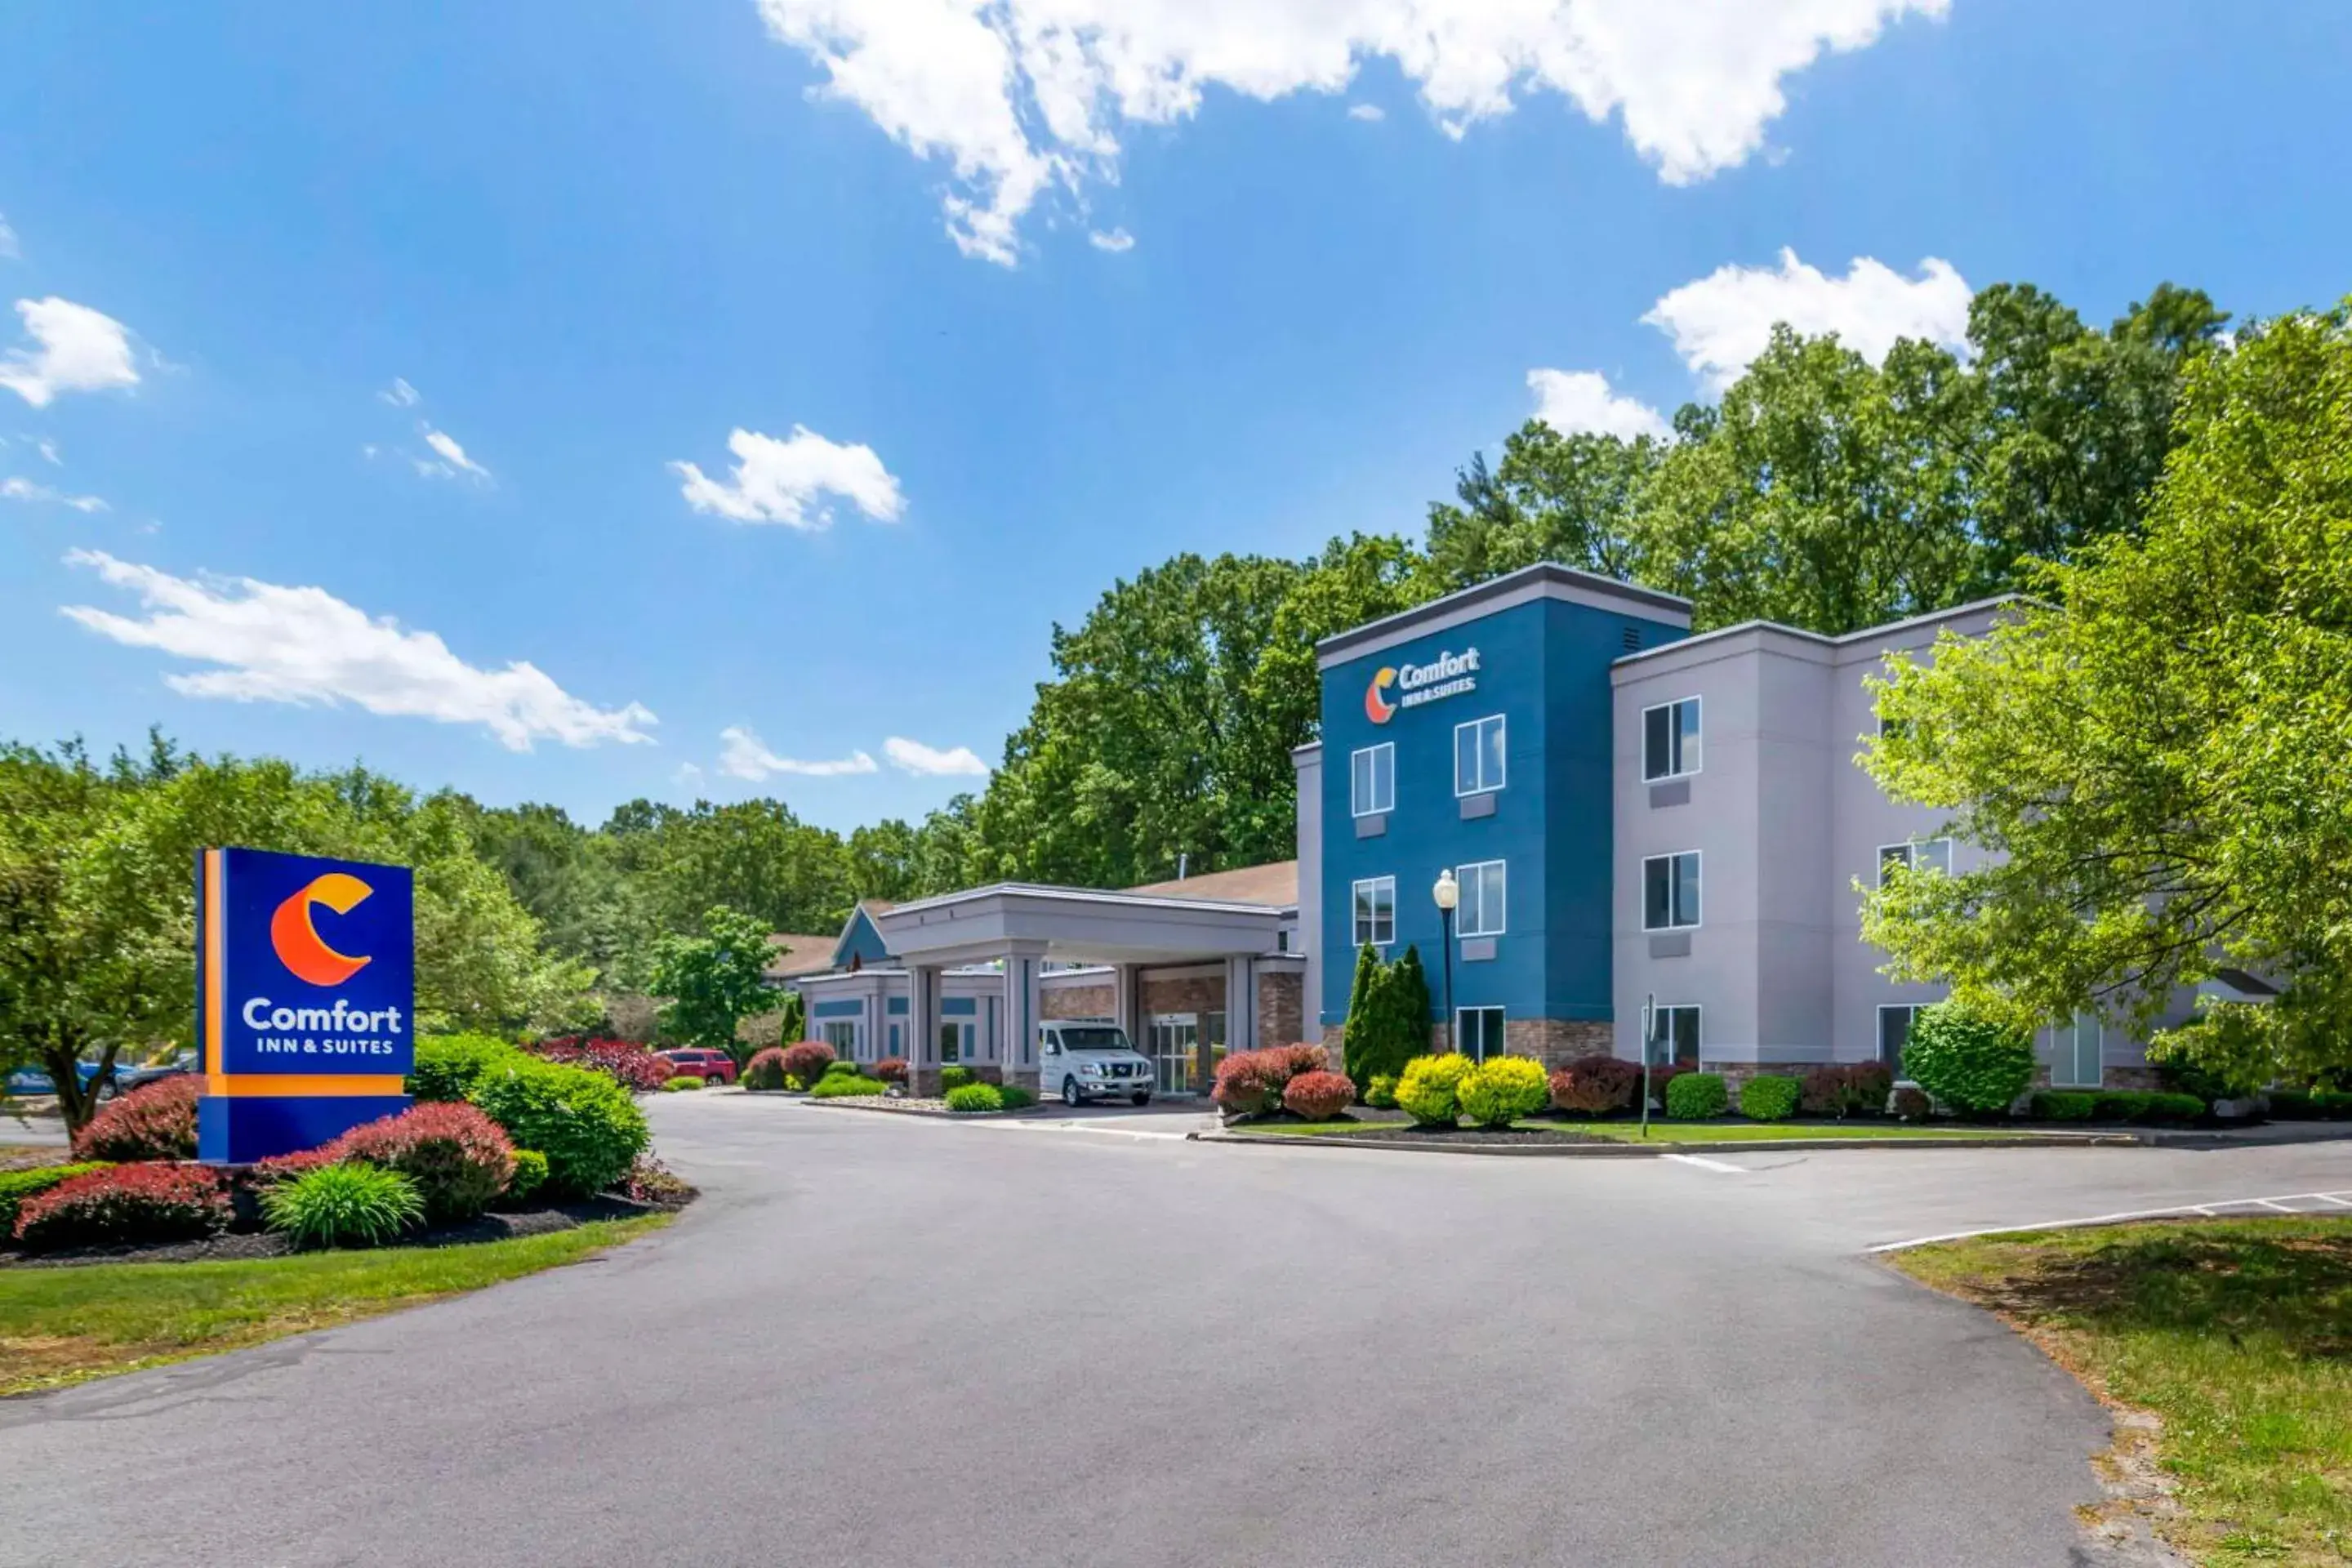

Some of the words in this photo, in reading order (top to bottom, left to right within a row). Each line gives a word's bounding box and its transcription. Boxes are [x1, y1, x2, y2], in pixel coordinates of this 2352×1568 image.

[1399, 647, 1480, 689] Comfort
[1401, 692, 1423, 707] INN
[1434, 677, 1476, 697] SUITES
[243, 996, 402, 1033] Comfort
[256, 1037, 298, 1053] INN
[303, 1038, 318, 1054] &
[323, 1039, 394, 1054] SUITES
